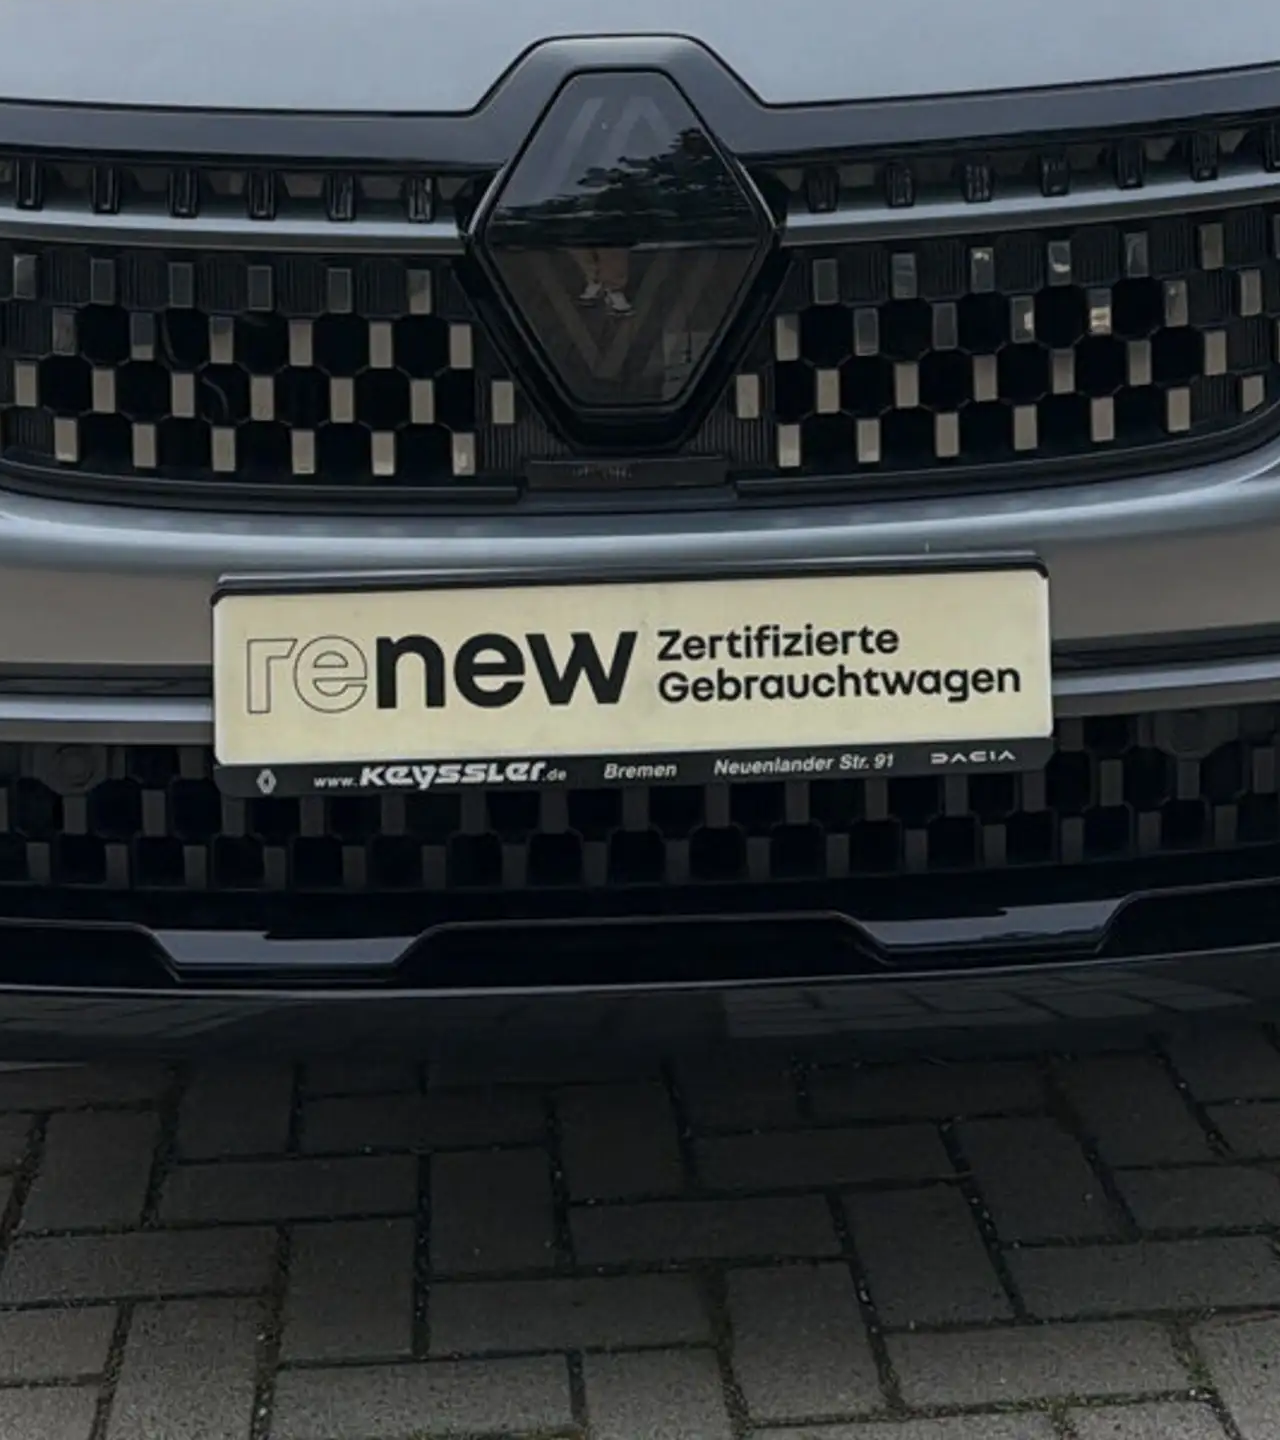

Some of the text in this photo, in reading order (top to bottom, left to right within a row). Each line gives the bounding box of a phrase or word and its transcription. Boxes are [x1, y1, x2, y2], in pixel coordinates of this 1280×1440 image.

[656, 624, 900, 662] Zertifizierte
[246, 631, 639, 715] renew
[657, 664, 1022, 704] Gebrauchtwagen
[603, 762, 678, 781] Bremen
[714, 757, 832, 776] Neuenlander
[838, 754, 870, 772] Str.
[874, 753, 894, 770] 91
[930, 749, 1017, 765] DACIA
